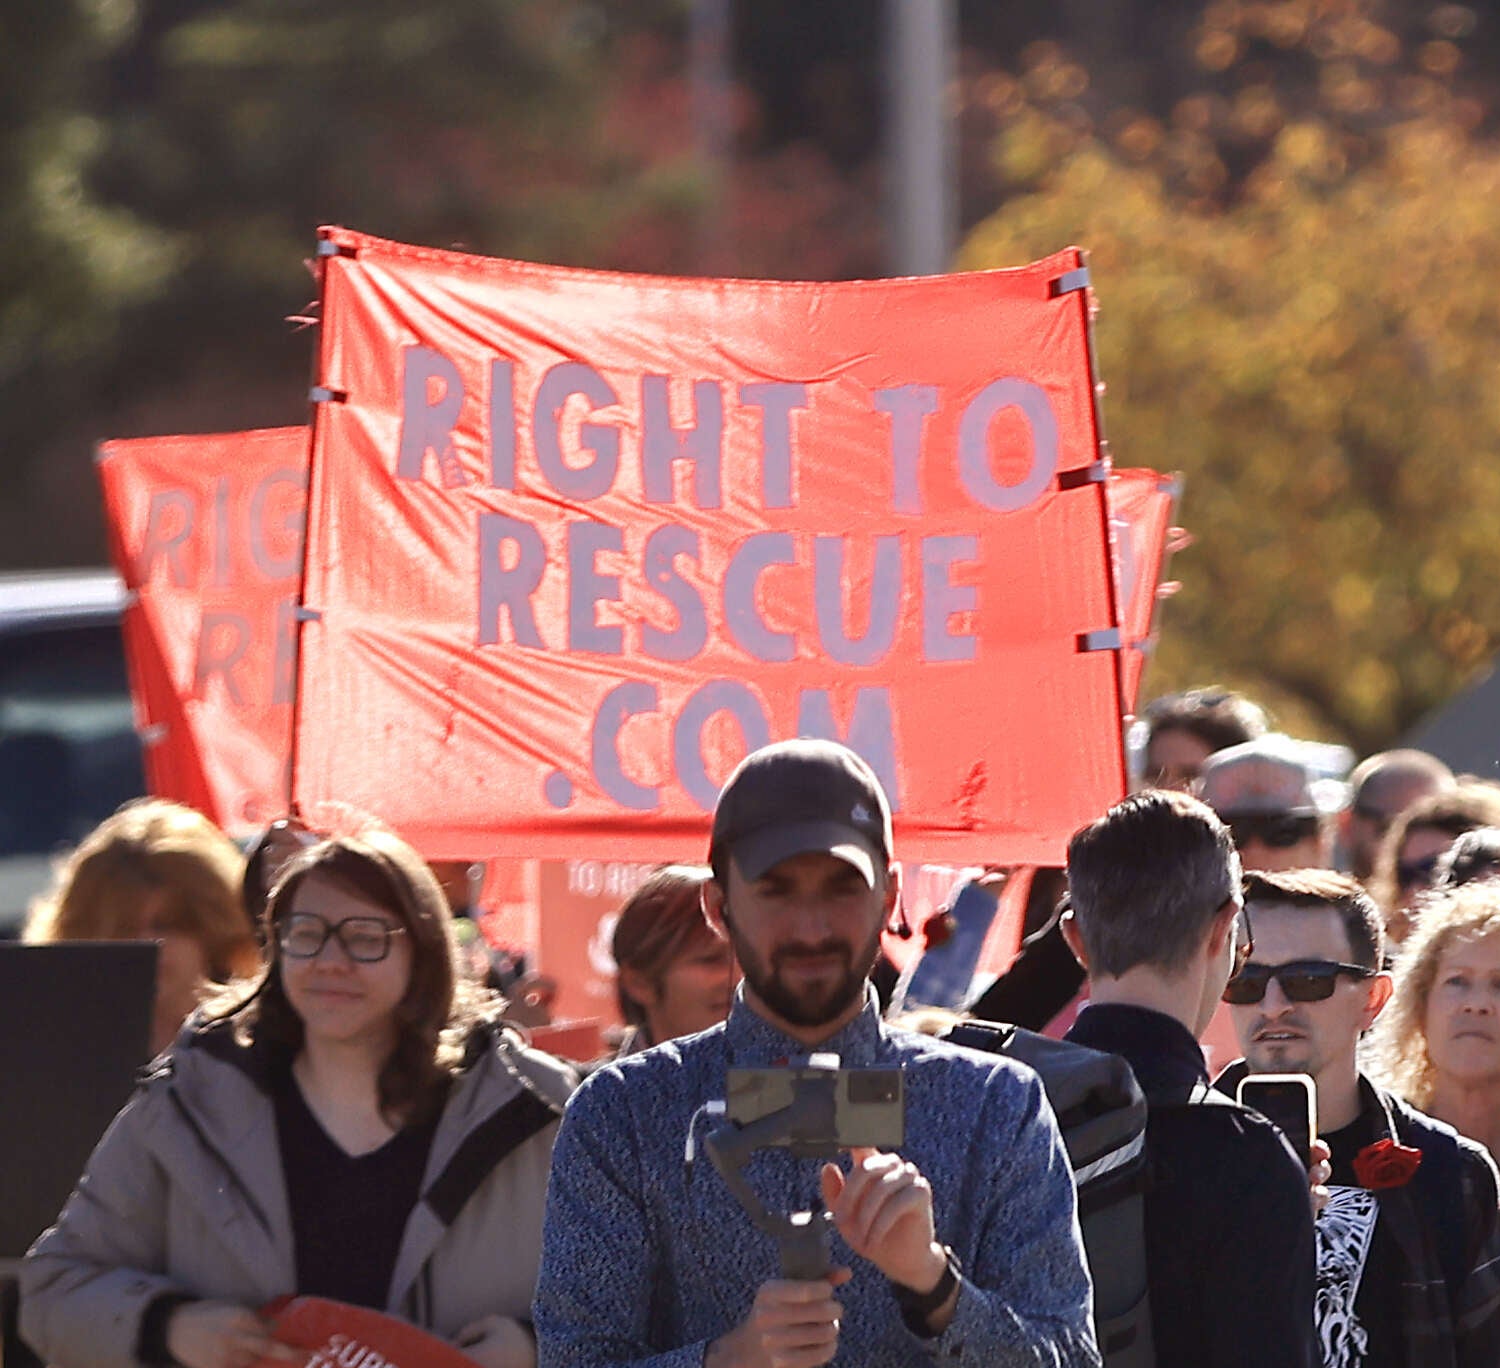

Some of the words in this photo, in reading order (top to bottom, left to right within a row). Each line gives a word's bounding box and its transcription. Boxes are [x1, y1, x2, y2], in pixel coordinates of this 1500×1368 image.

[401, 345, 806, 511] RIGHT
[873, 375, 1061, 516] TO
[478, 512, 979, 667] RESCUE
[546, 676, 904, 812] .COM
